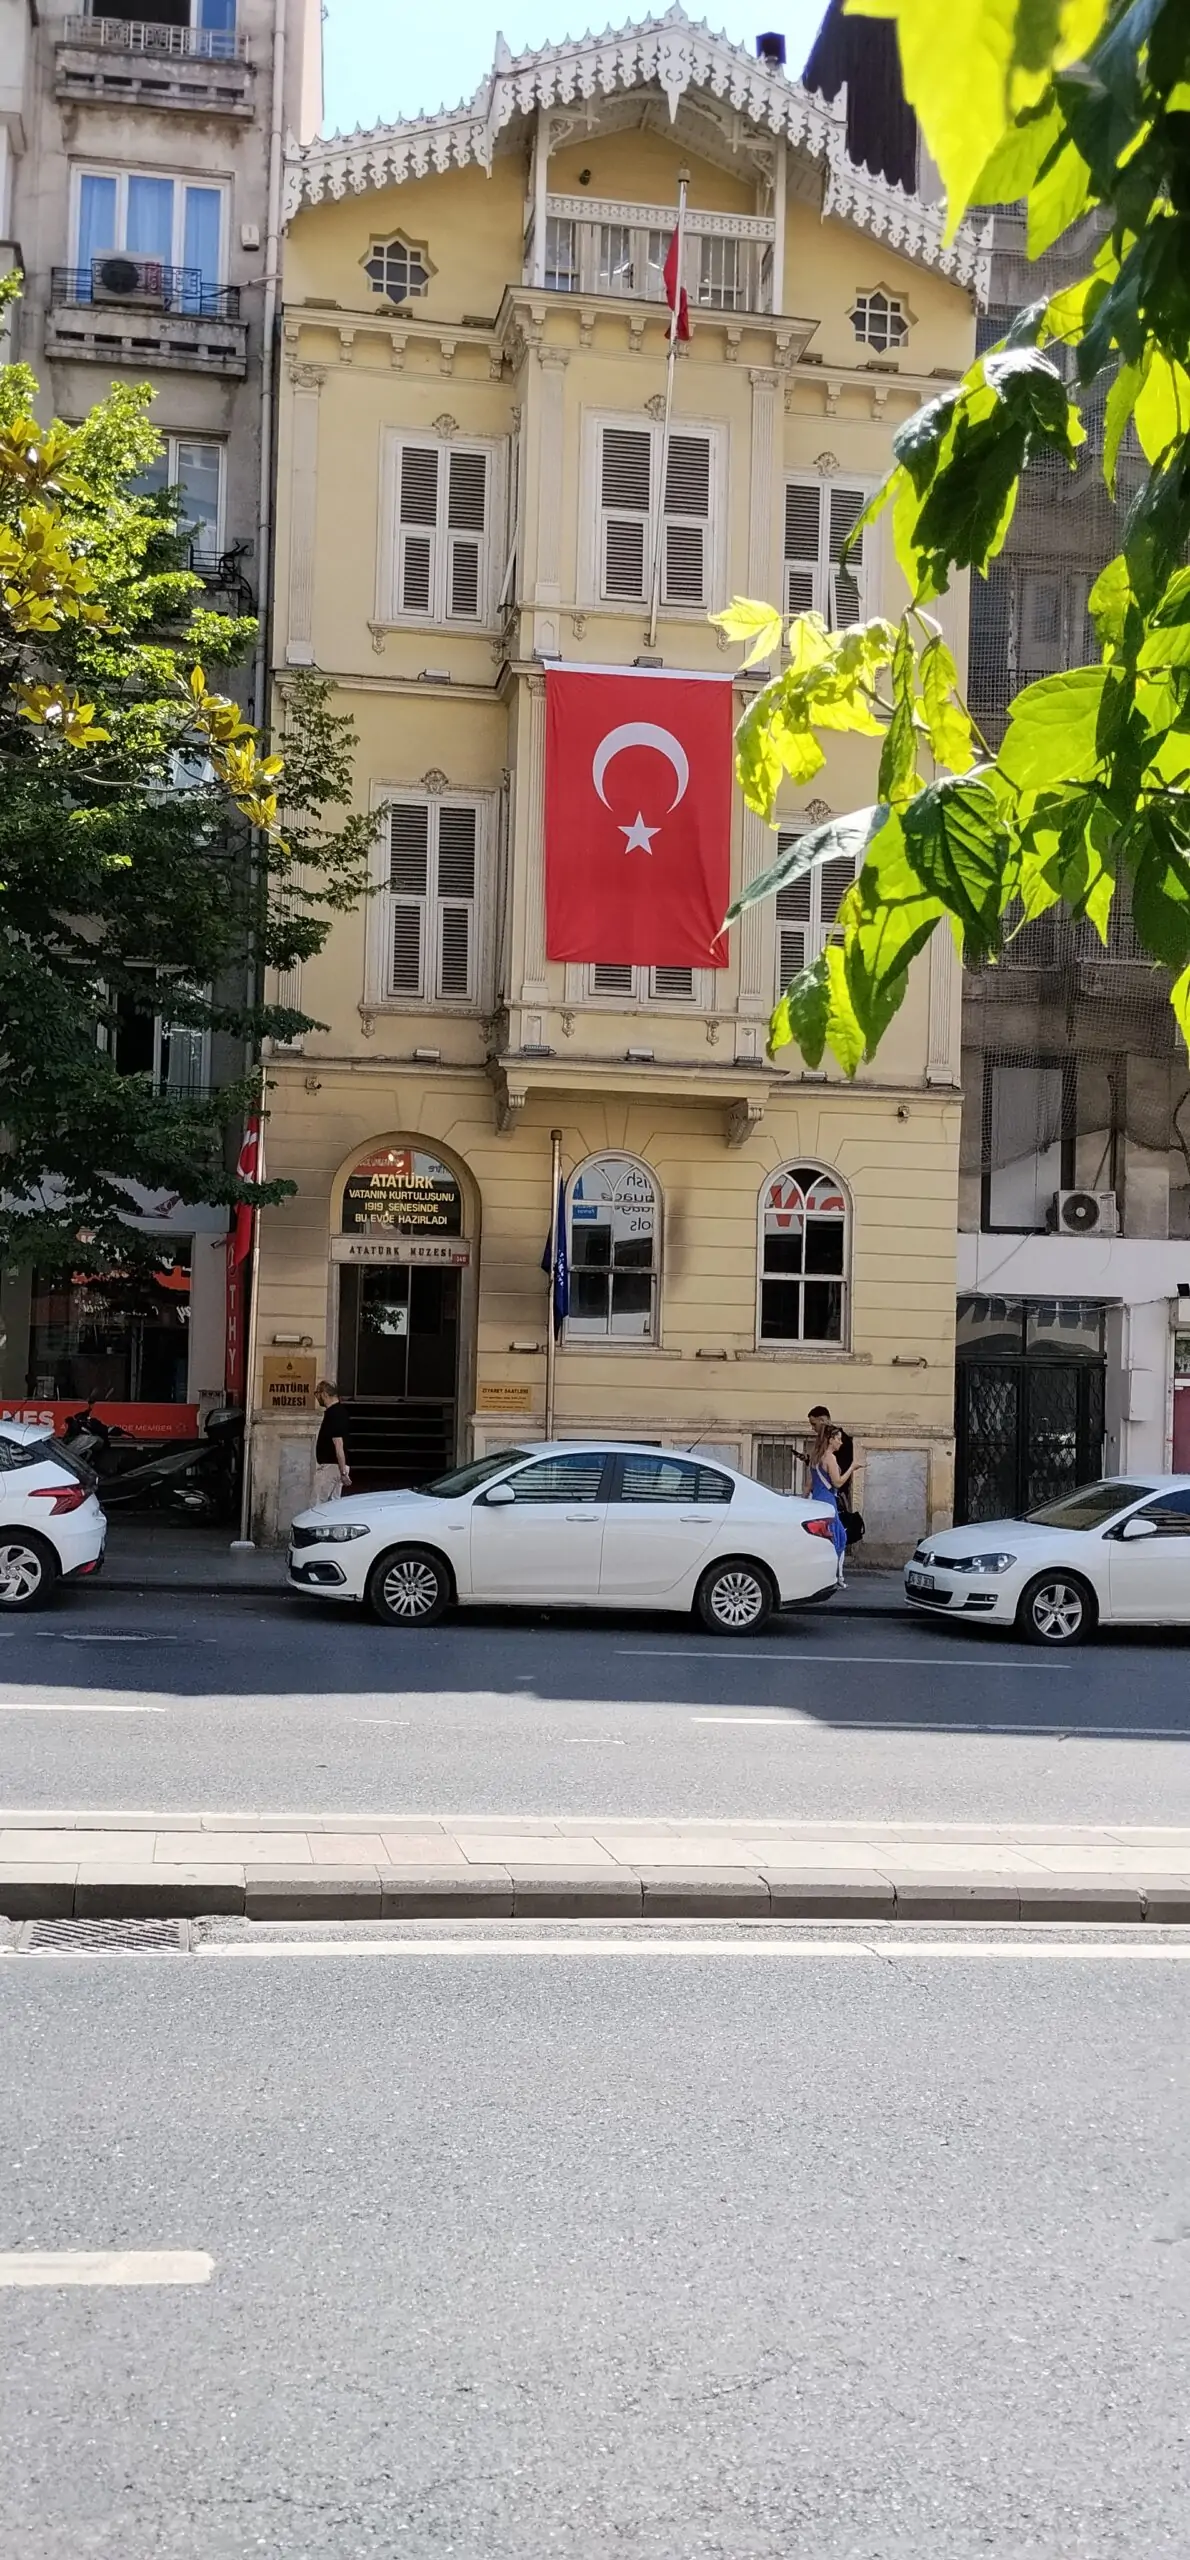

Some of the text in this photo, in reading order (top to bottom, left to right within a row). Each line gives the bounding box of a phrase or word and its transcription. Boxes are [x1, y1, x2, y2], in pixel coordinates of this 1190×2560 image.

[370, 1172, 434, 1189] ATATÜRK
[349, 1189, 454, 1202] VATANIN KURTULUŞUNU
[364, 1202, 439, 1213] 1919 SENESİNDE
[355, 1213, 448, 1225] BU EVDE HAZIRLADI
[228, 1284, 237, 1376] THY
[269, 1381, 309, 1394] ATATÜRK
[272, 1395, 306, 1407] MÜZESİ
